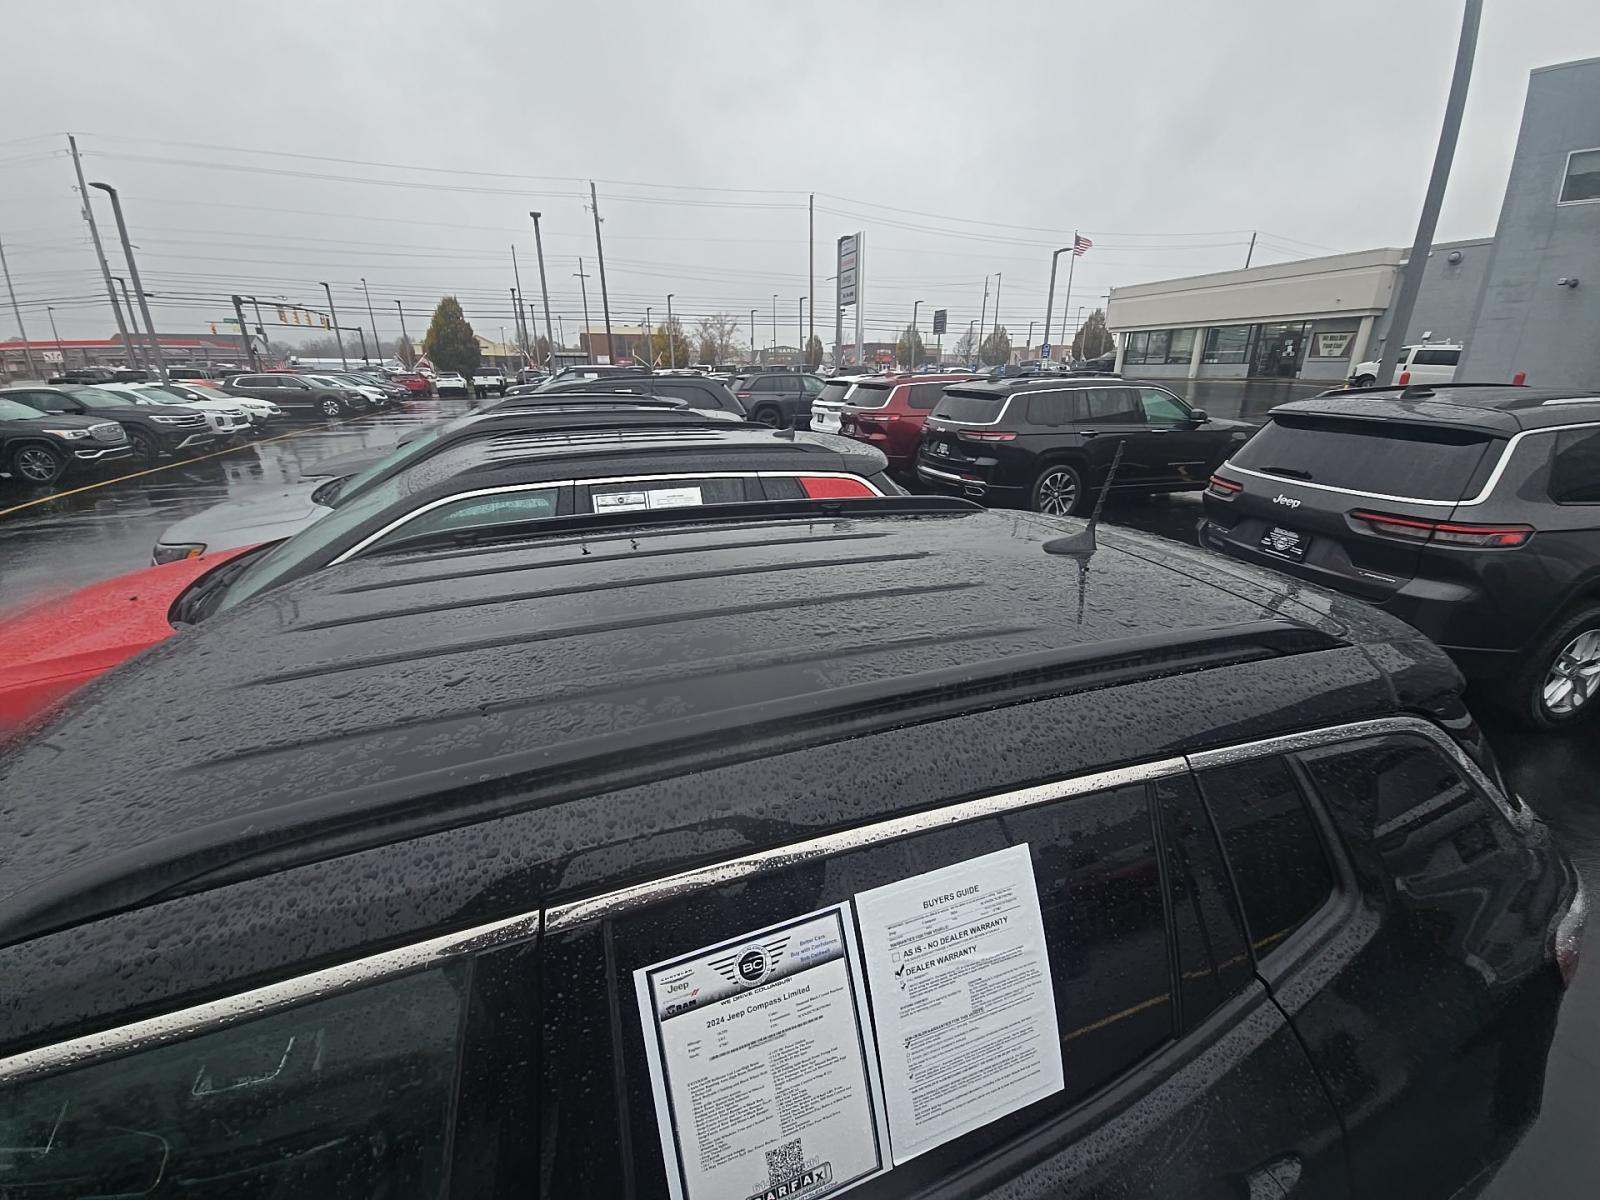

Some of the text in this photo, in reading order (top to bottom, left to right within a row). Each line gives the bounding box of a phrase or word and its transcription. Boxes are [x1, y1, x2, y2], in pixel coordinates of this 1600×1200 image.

[1272, 493, 1301, 509] Jeep
[923, 885, 980, 909] BUYERS GUIDE
[903, 948, 914, 959] AS
[914, 945, 923, 954] IS
[927, 940, 939, 950] NO
[939, 930, 969, 946] DEALER
[970, 916, 1008, 937] WARRANTY
[742, 958, 764, 974] BC
[905, 945, 977, 976] DEALER WARRANTY
[667, 982, 689, 994] Jeep
[681, 998, 698, 1013] RAM
[705, 984, 811, 1029] 2024 Jeep Compass Limited
[754, 1171, 824, 1200] ARFAX
